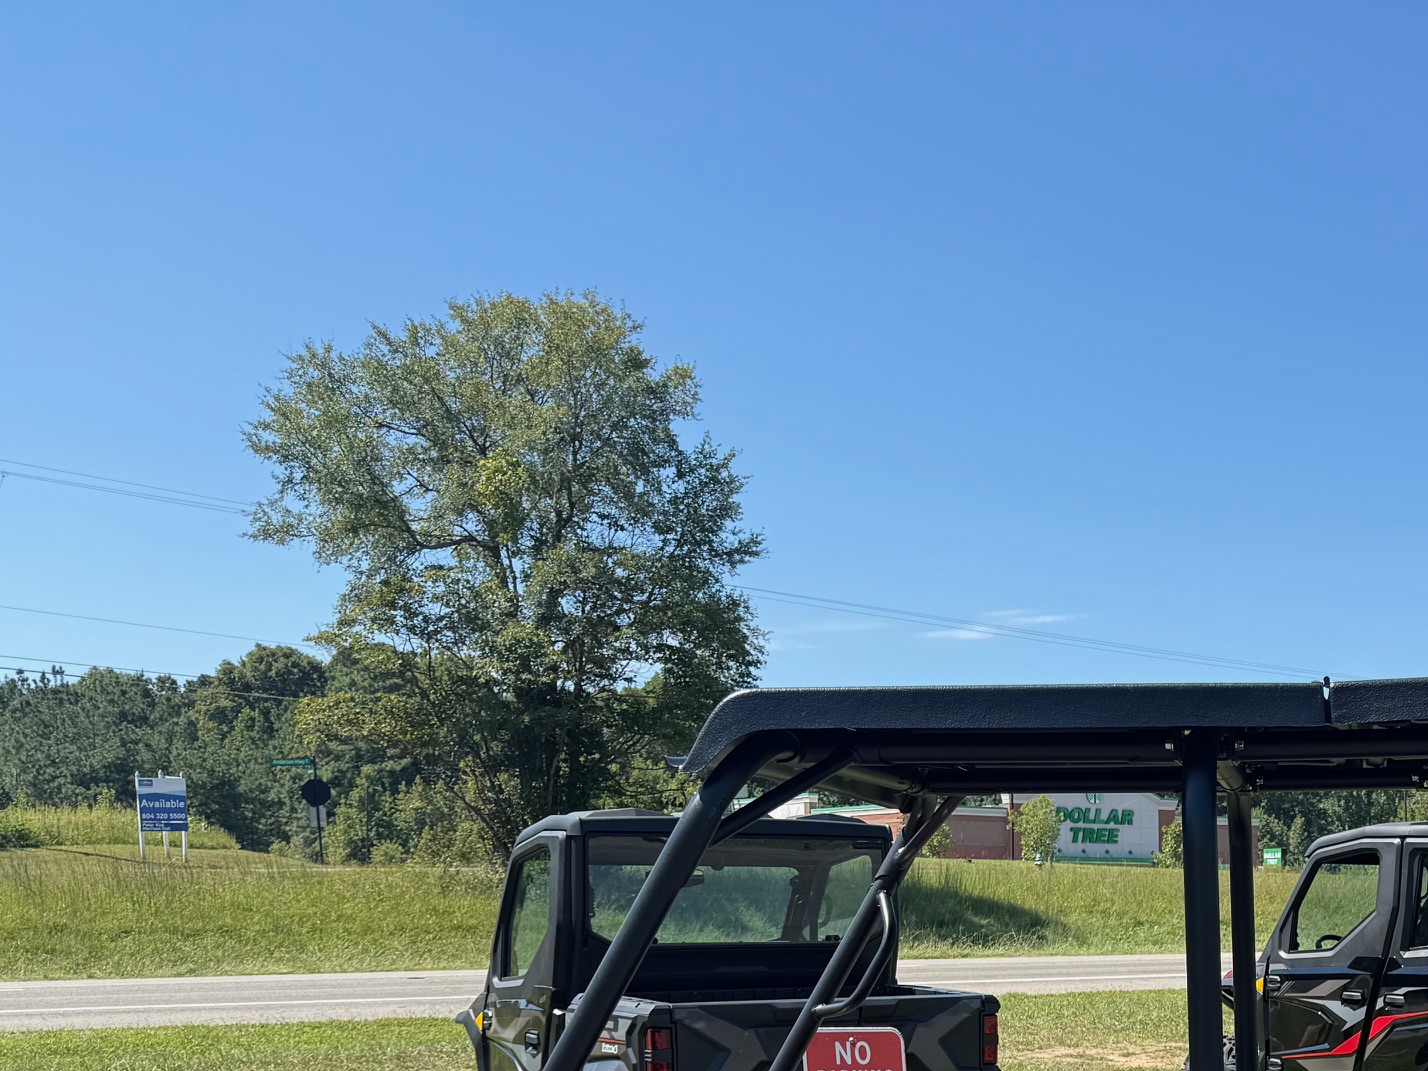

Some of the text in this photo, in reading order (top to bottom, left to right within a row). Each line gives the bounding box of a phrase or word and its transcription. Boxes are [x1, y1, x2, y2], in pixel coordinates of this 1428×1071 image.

[141, 799, 185, 808] Available
[1055, 807, 1134, 825] DOLLAR
[1070, 827, 1120, 844] TREE
[835, 1041, 871, 1065] NO
